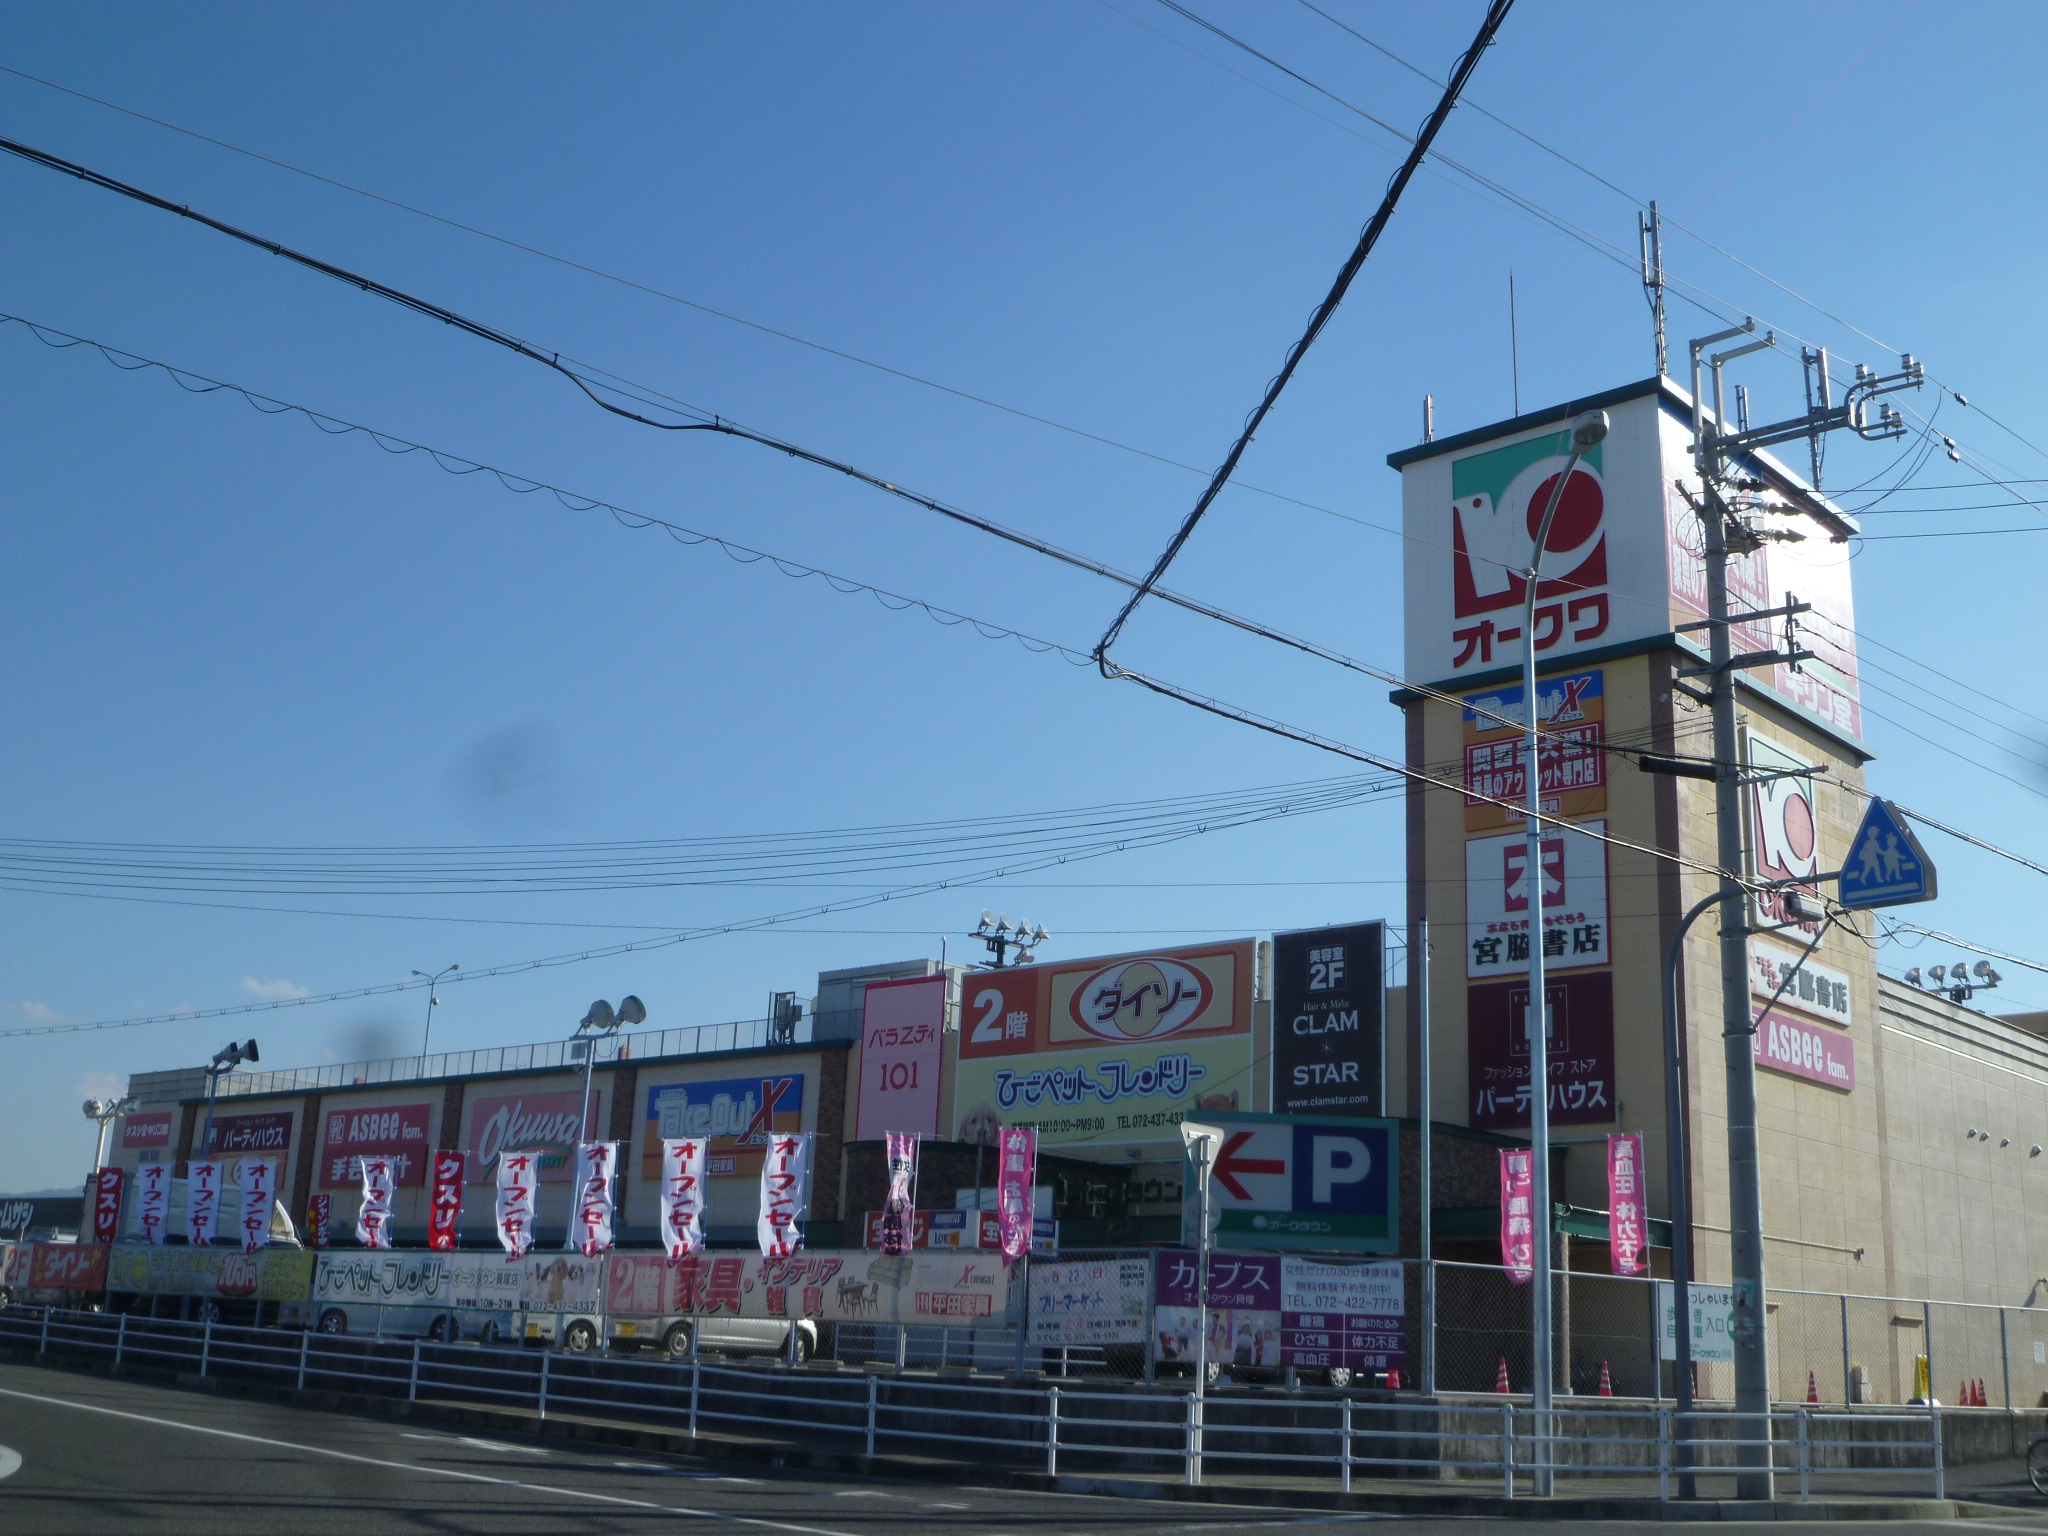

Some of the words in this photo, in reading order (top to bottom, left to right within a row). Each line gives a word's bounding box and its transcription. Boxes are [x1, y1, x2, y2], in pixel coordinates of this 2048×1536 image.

[1453, 592, 1610, 669] オークワ
[1309, 946, 1344, 964] 美容室
[1472, 924, 1602, 966] 宮脇書店
[1309, 962, 1345, 992] 2F
[1092, 979, 1201, 1024] ダイソー
[1303, 1002, 1319, 1012] Hair
[1329, 999, 1350, 1010] Make
[1292, 1010, 1359, 1036] CLAM
[1768, 1021, 1823, 1072] ASBee
[1827, 1053, 1849, 1081] fam.
[880, 1060, 919, 1092] 101
[1293, 1061, 1360, 1086] STAR
[1570, 1059, 1597, 1074] ストア
[1287, 1094, 1369, 1109] www.clamstar.com
[1476, 1080, 1608, 1116] パーテハウス
[348, 1112, 400, 1142] ASBee
[402, 1122, 423, 1140] fam.
[479, 1100, 581, 1166] Okuwa
[1116, 1114, 1131, 1129] TEL
[1132, 1112, 1185, 1128] 072-437-433
[224, 1128, 283, 1149] パーティハウス
[1311, 1135, 1371, 1204] P
[99, 1172, 120, 1230] クスリ
[436, 1159, 460, 1230] クスリ
[6, 1248, 29, 1283] 2F
[1315, 1295, 1400, 1310] 072-422-7778
[1299, 1314, 1325, 1328] 腰痛
[1350, 1317, 1400, 1330] お腹のたるみ
[1705, 1316, 1725, 1333] 入口
[1294, 1333, 1330, 1348] ひざ痛
[1352, 1335, 1400, 1351] 体力不足
[1292, 1352, 1330, 1367] 高血圧
[1363, 1354, 1388, 1369] 体重
